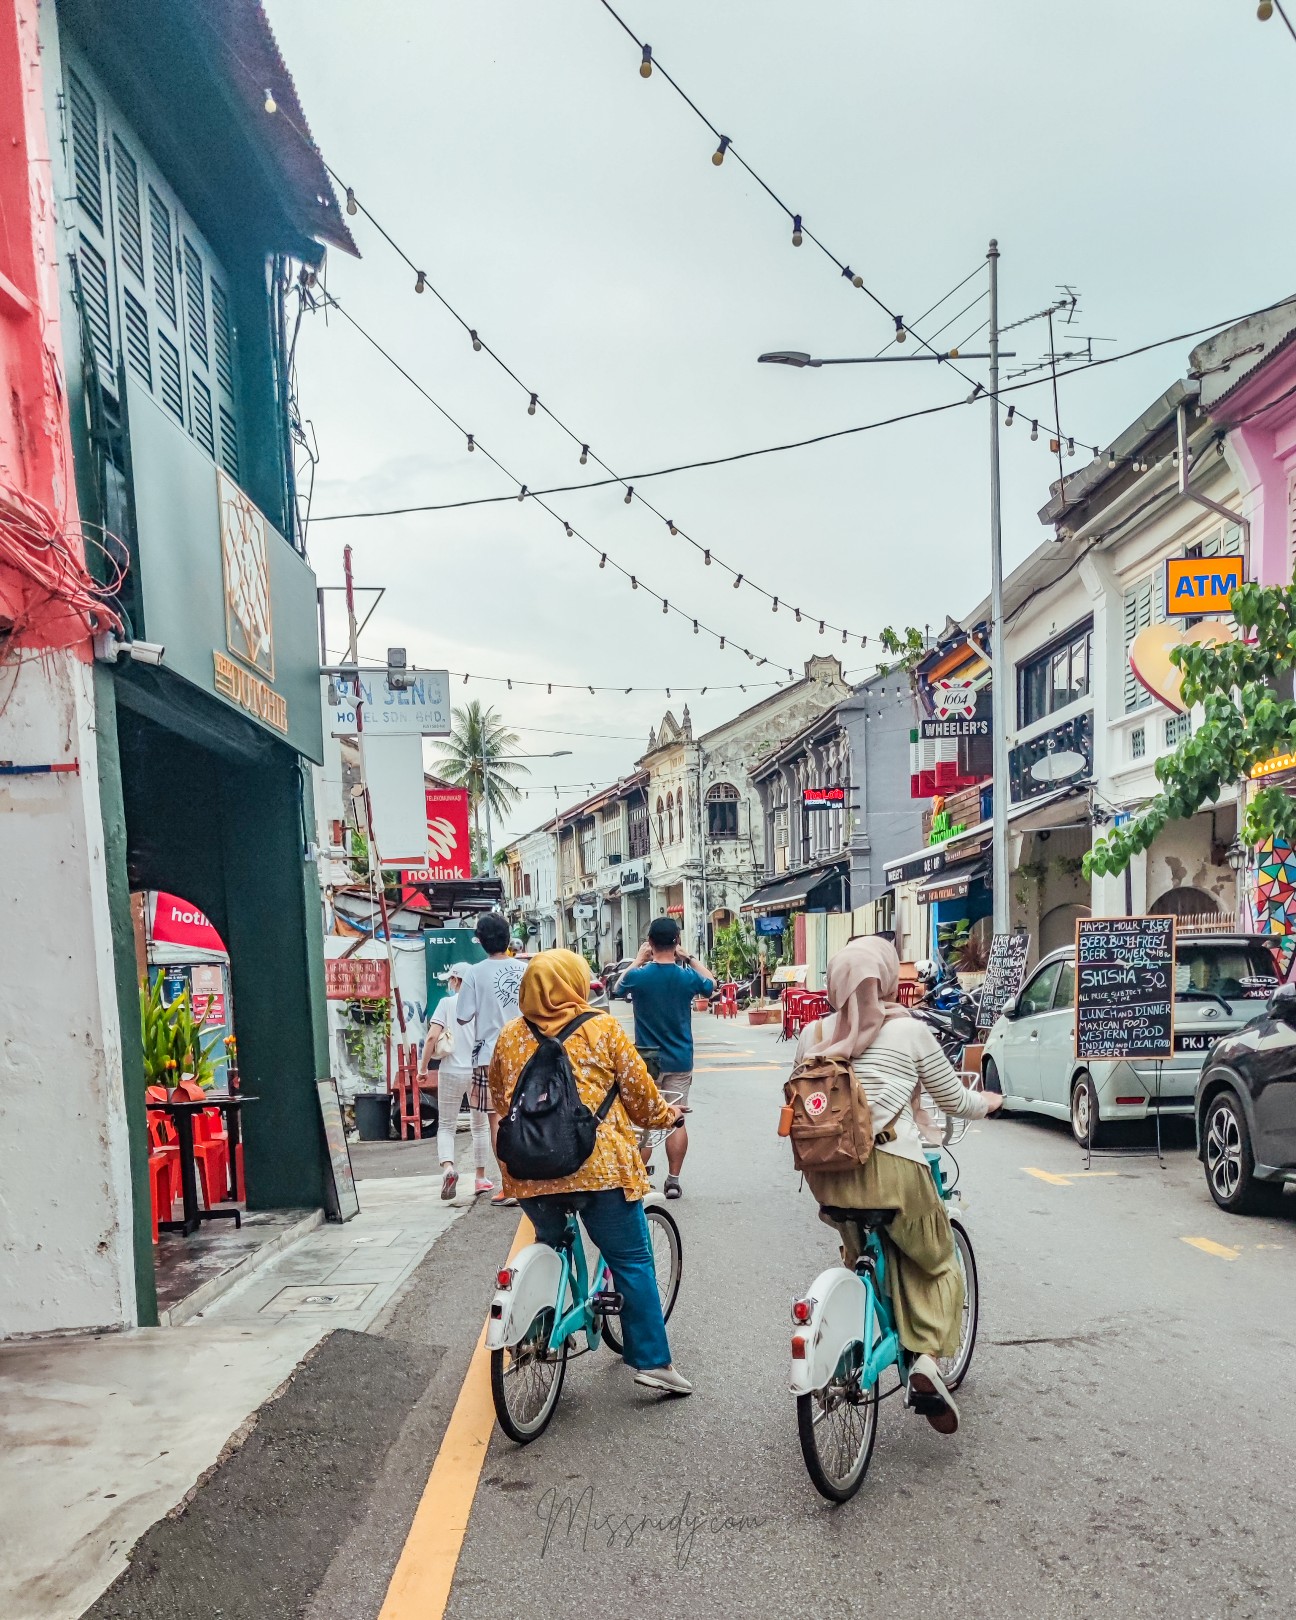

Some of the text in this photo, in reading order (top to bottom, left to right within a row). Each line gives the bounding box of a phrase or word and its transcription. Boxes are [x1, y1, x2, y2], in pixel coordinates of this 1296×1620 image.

[1175, 573, 1237, 598] ATM
[232, 664, 287, 732] DUTCHIE
[943, 693, 969, 705] 1664
[337, 711, 378, 723] HOEL
[925, 720, 988, 737] WHEELER'S
[171, 906, 214, 928] hotli
[1080, 921, 1110, 932] HAPPY
[1113, 919, 1140, 931] HOUR
[1080, 936, 1108, 949] BEER
[1080, 949, 1108, 963] BEER
[1111, 948, 1147, 961] TOWER
[365, 973, 376, 982] FOR
[1081, 969, 1137, 988] SHISHA
[1140, 971, 1165, 988] 30
[1079, 993, 1090, 1002] ALL
[1091, 991, 1109, 1000] PRICE
[1250, 989, 1272, 998] MAC
[1080, 1004, 1171, 1020] LUNCH AND DINNER
[1079, 1017, 1149, 1031] MAXICAN FOOD
[1079, 1025, 1164, 1041] WESTERN FOOD
[1079, 1041, 1115, 1051] INDIAN
[1128, 1039, 1153, 1049] LOCAL
[1153, 1038, 1171, 1048] FOOD
[1182, 1037, 1220, 1049] PKJ 2
[1080, 1049, 1129, 1057] DESSERT
